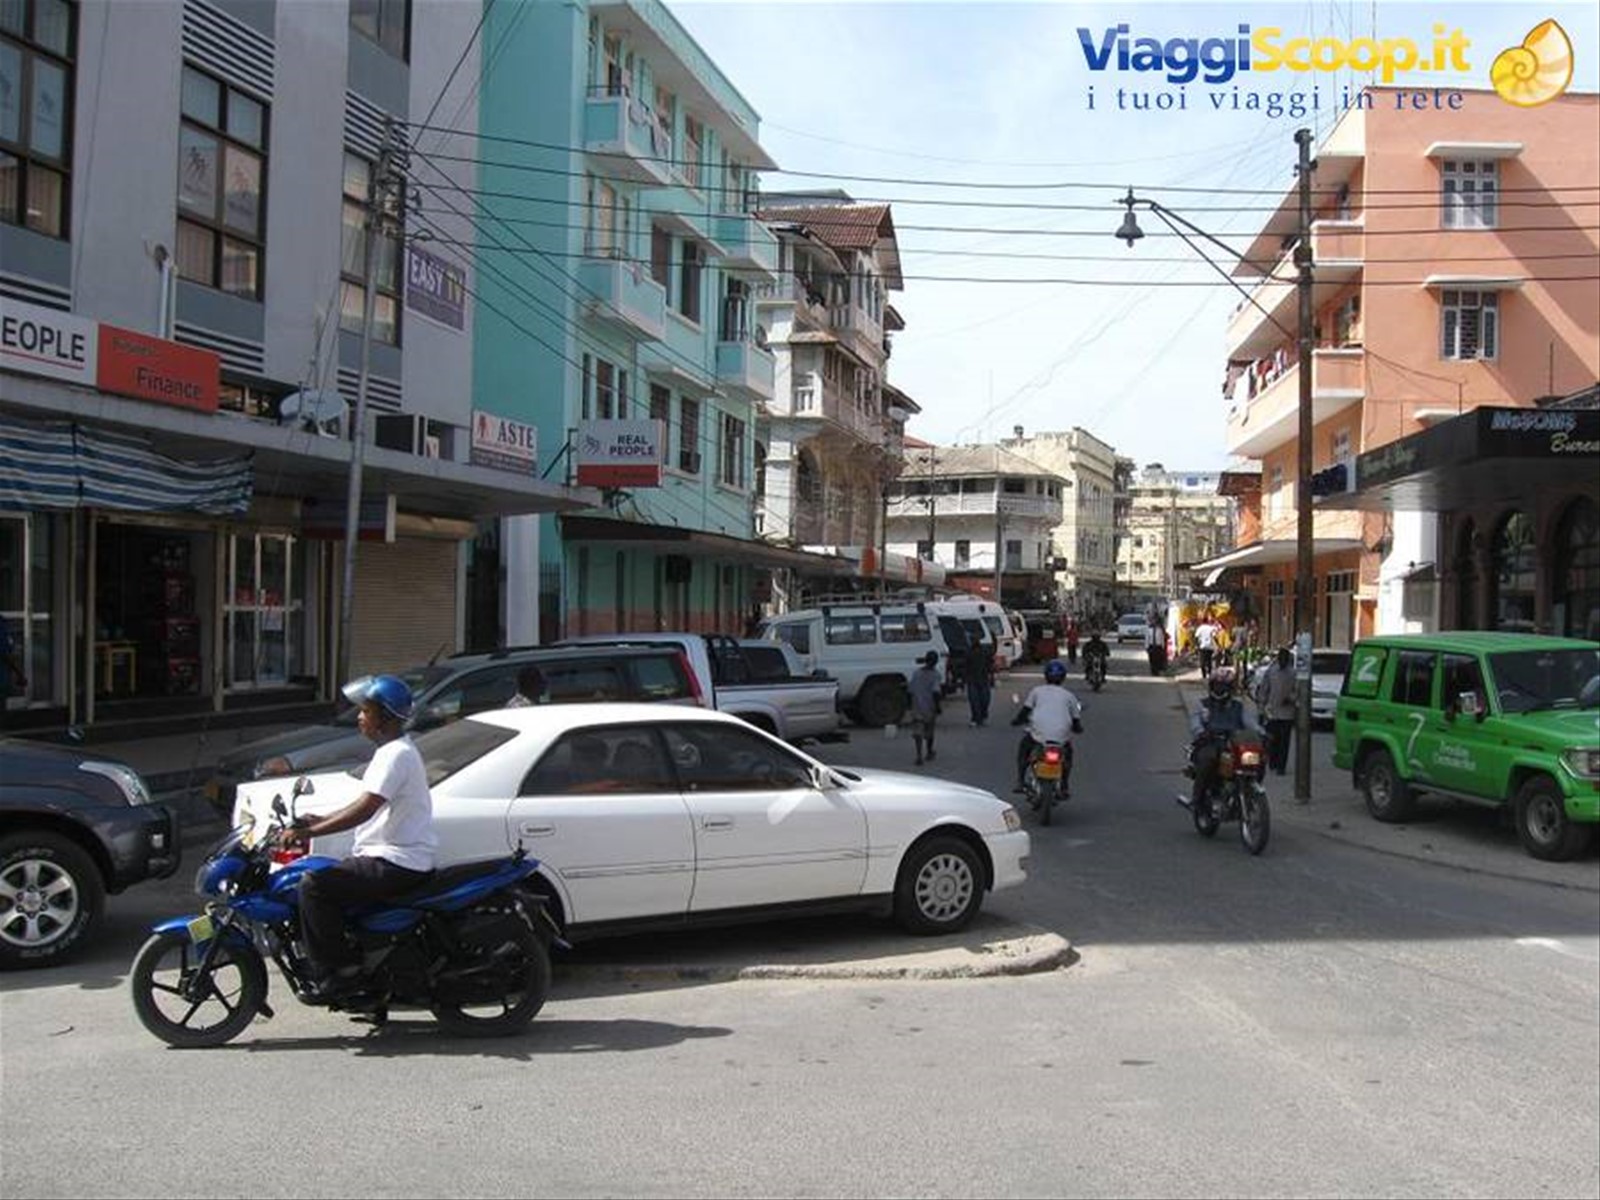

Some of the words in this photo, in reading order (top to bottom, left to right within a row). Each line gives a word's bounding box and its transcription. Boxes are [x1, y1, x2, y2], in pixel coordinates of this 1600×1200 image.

[411, 252, 444, 297] EASY
[2, 316, 85, 363] EOPLE
[136, 366, 203, 398] Finance
[497, 421, 534, 449] ASTE
[617, 434, 649, 445] REAL
[609, 445, 654, 456] PEOPLE
